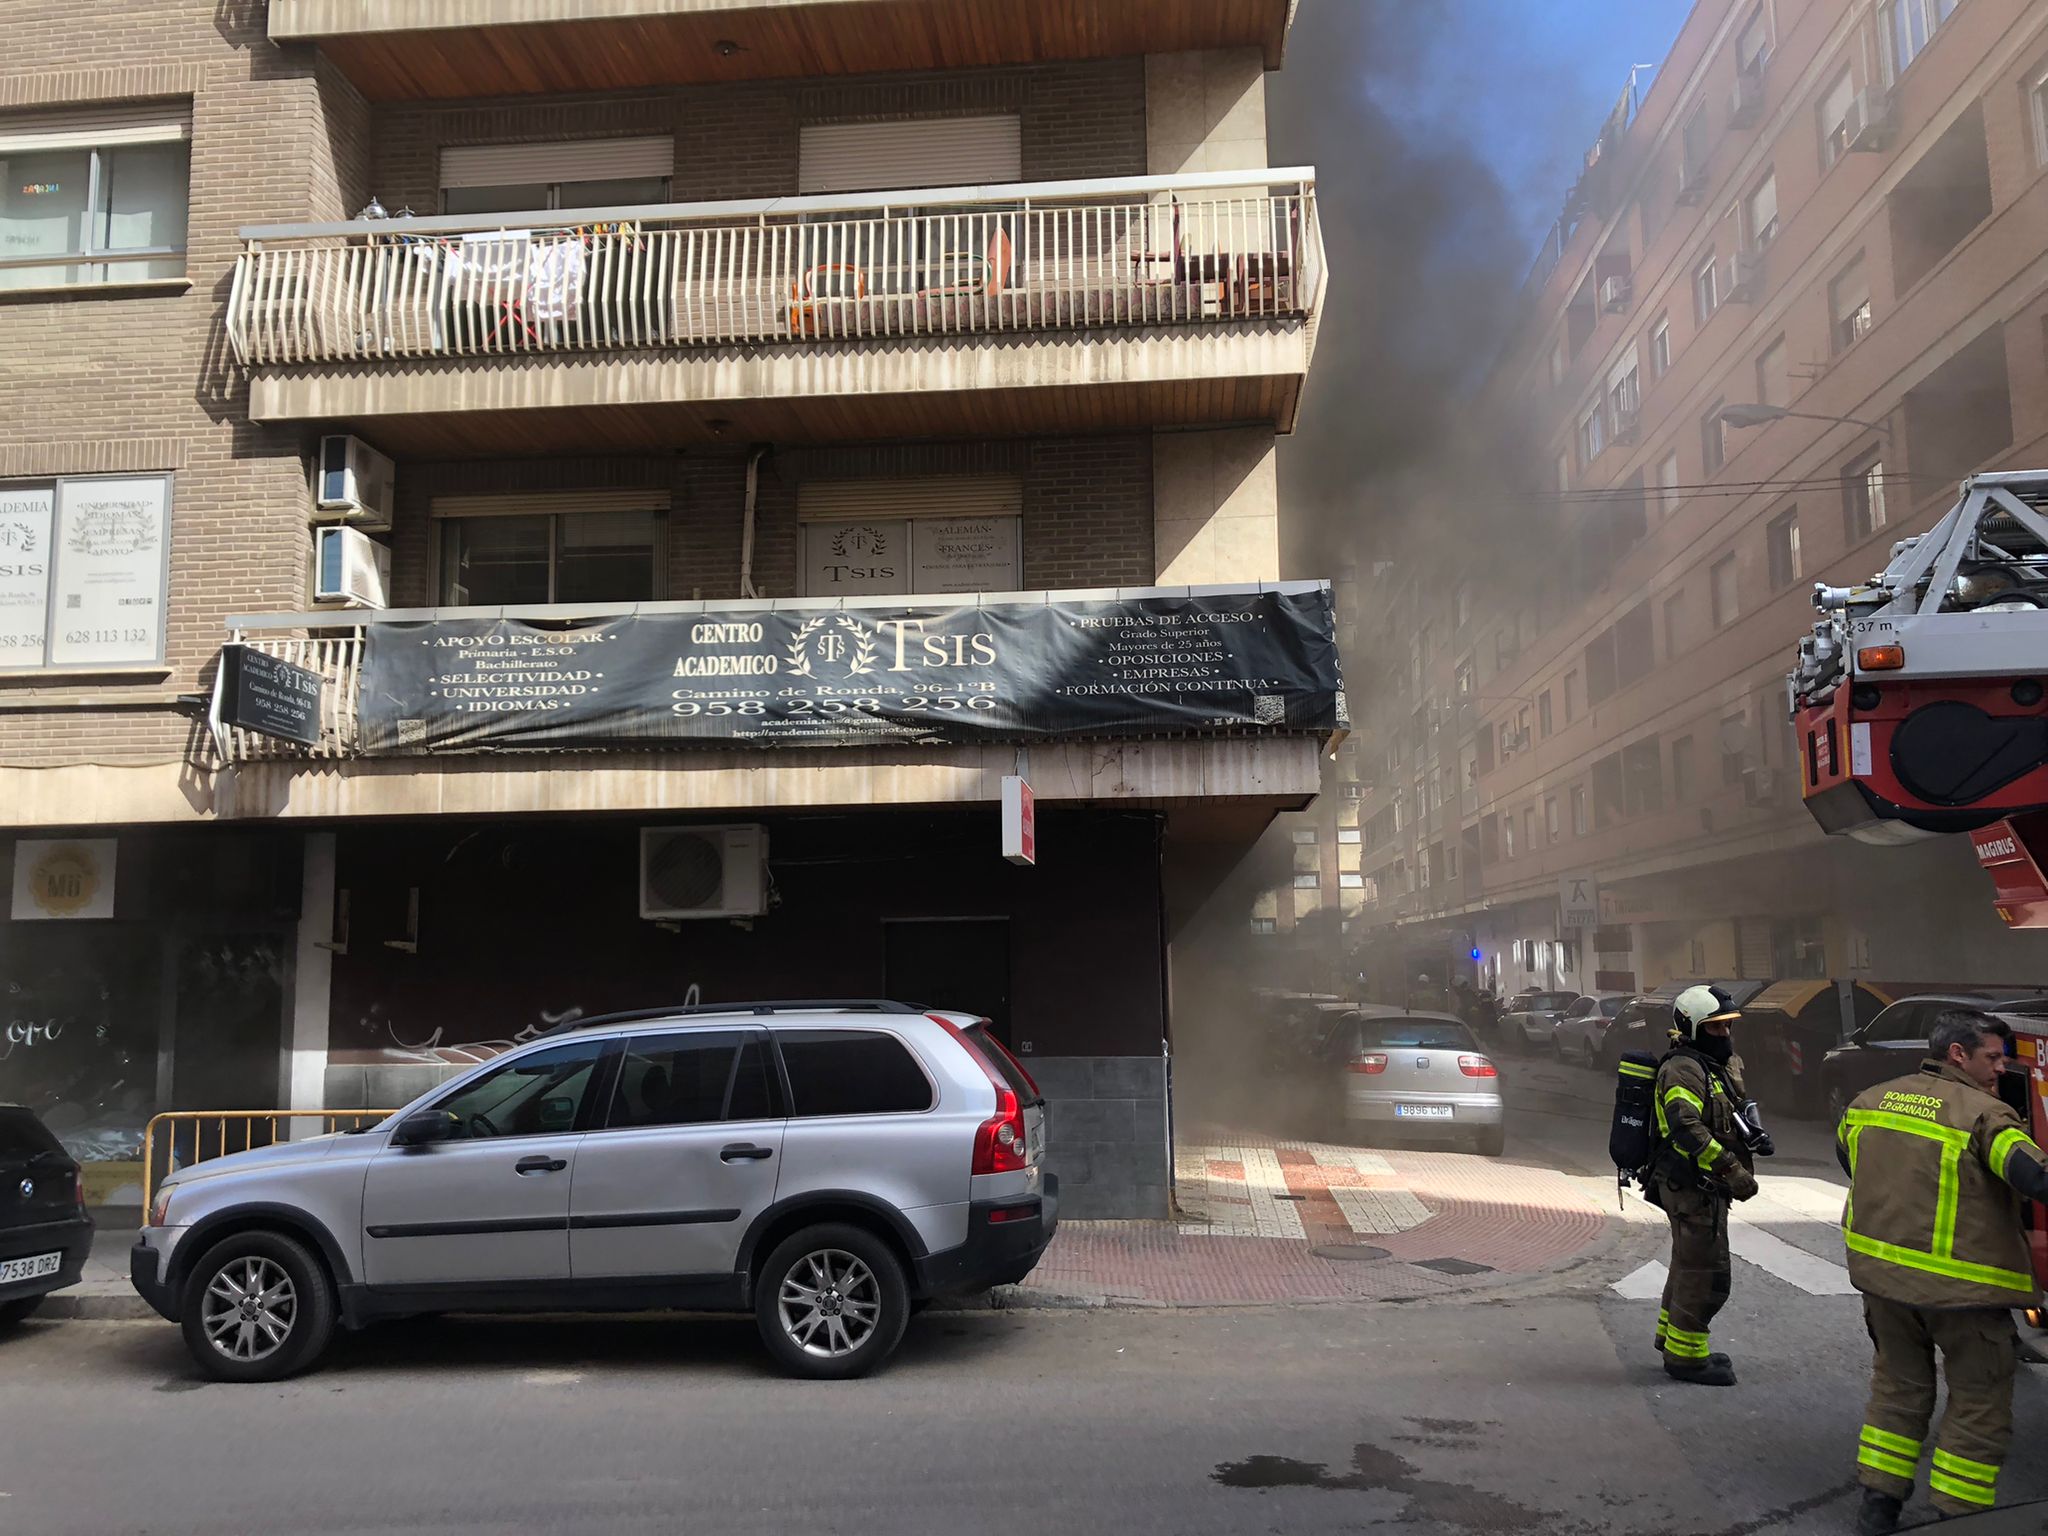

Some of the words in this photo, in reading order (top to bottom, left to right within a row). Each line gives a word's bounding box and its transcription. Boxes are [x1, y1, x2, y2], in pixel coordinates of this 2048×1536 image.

[0, 501, 49, 514] DEMIA
[1080, 616, 1154, 629] PRUEBAS
[1159, 615, 1182, 626] DE
[1185, 611, 1254, 624] ACCESO
[1856, 621, 1875, 633] 37
[1879, 622, 1893, 632] m
[66, 629, 90, 644] 628
[96, 628, 118, 643] 113
[124, 628, 147, 643] 132
[433, 635, 505, 648] APOYO
[510, 632, 604, 646] ESCOLAR
[690, 623, 764, 645] CENTRO
[1120, 629, 1158, 640] Grado
[1160, 627, 1210, 640] Superior
[0, 634, 18, 649] 58
[1109, 641, 1158, 653] Mayores
[1161, 640, 1175, 650] de
[1177, 639, 1192, 649] 25
[1195, 638, 1222, 649] años
[458, 648, 518, 659] Primaria
[531, 646, 577, 657] E.S.O.
[1108, 651, 1224, 666] OPOSICIONES
[475, 659, 558, 670] Bachillerato
[673, 654, 778, 678] ACADEMICO
[440, 670, 592, 685] SELECTIVIDAD
[1122, 666, 1211, 680] EMPRESAS
[442, 684, 587, 699] UNIVERSIDAD
[672, 687, 770, 701] Camino
[778, 686, 801, 698] de
[816, 684, 905, 697] Ronda,
[1065, 680, 1171, 696] FORMACIÓN
[1175, 677, 1270, 692] CONTINUA
[467, 699, 559, 713] IDIOMAS
[671, 700, 767, 718] 958
[787, 697, 881, 715] 258
[901, 694, 997, 712] 256
[291, 709, 306, 720] 256
[1976, 836, 2016, 860] MAGIRUS
[1883, 1090, 1944, 1110] BOMBEROS
[1403, 1105, 1428, 1115] 9896
[1431, 1106, 1449, 1115] CNP
[3, 1260, 35, 1279] 7538
[38, 1255, 58, 1274] DRZ
